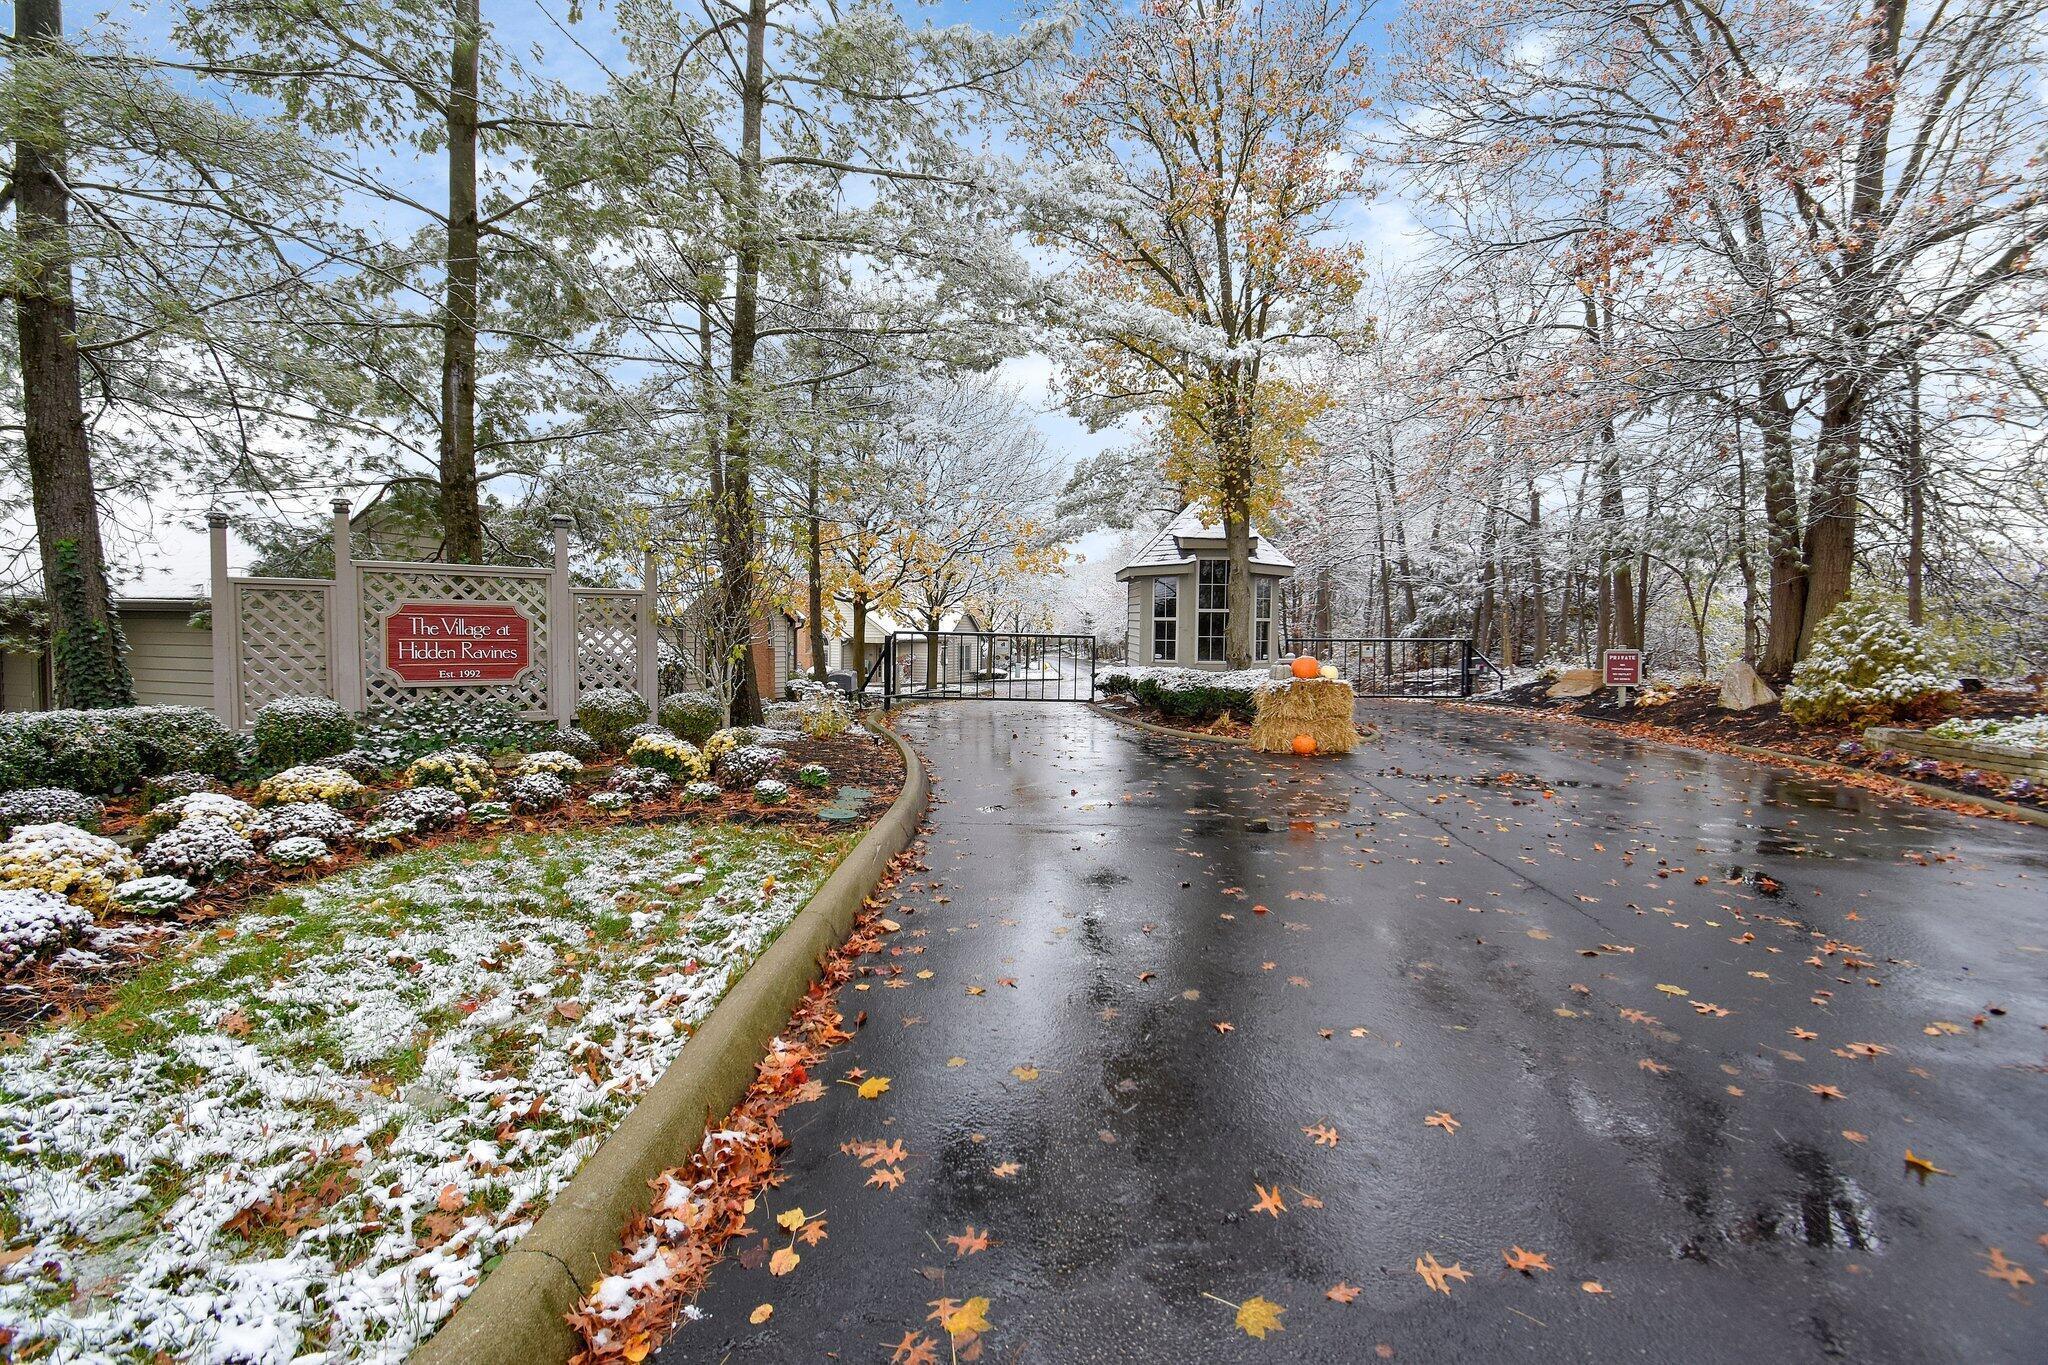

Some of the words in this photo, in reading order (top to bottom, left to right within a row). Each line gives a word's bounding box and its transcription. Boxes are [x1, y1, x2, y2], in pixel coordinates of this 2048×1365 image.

[408, 616, 439, 636] The
[441, 617, 491, 639] Village
[496, 621, 511, 637] at
[398, 641, 456, 660] Hidden
[461, 641, 518, 660] Ravines
[439, 669, 456, 678] Est.
[459, 669, 481, 678] 1992
